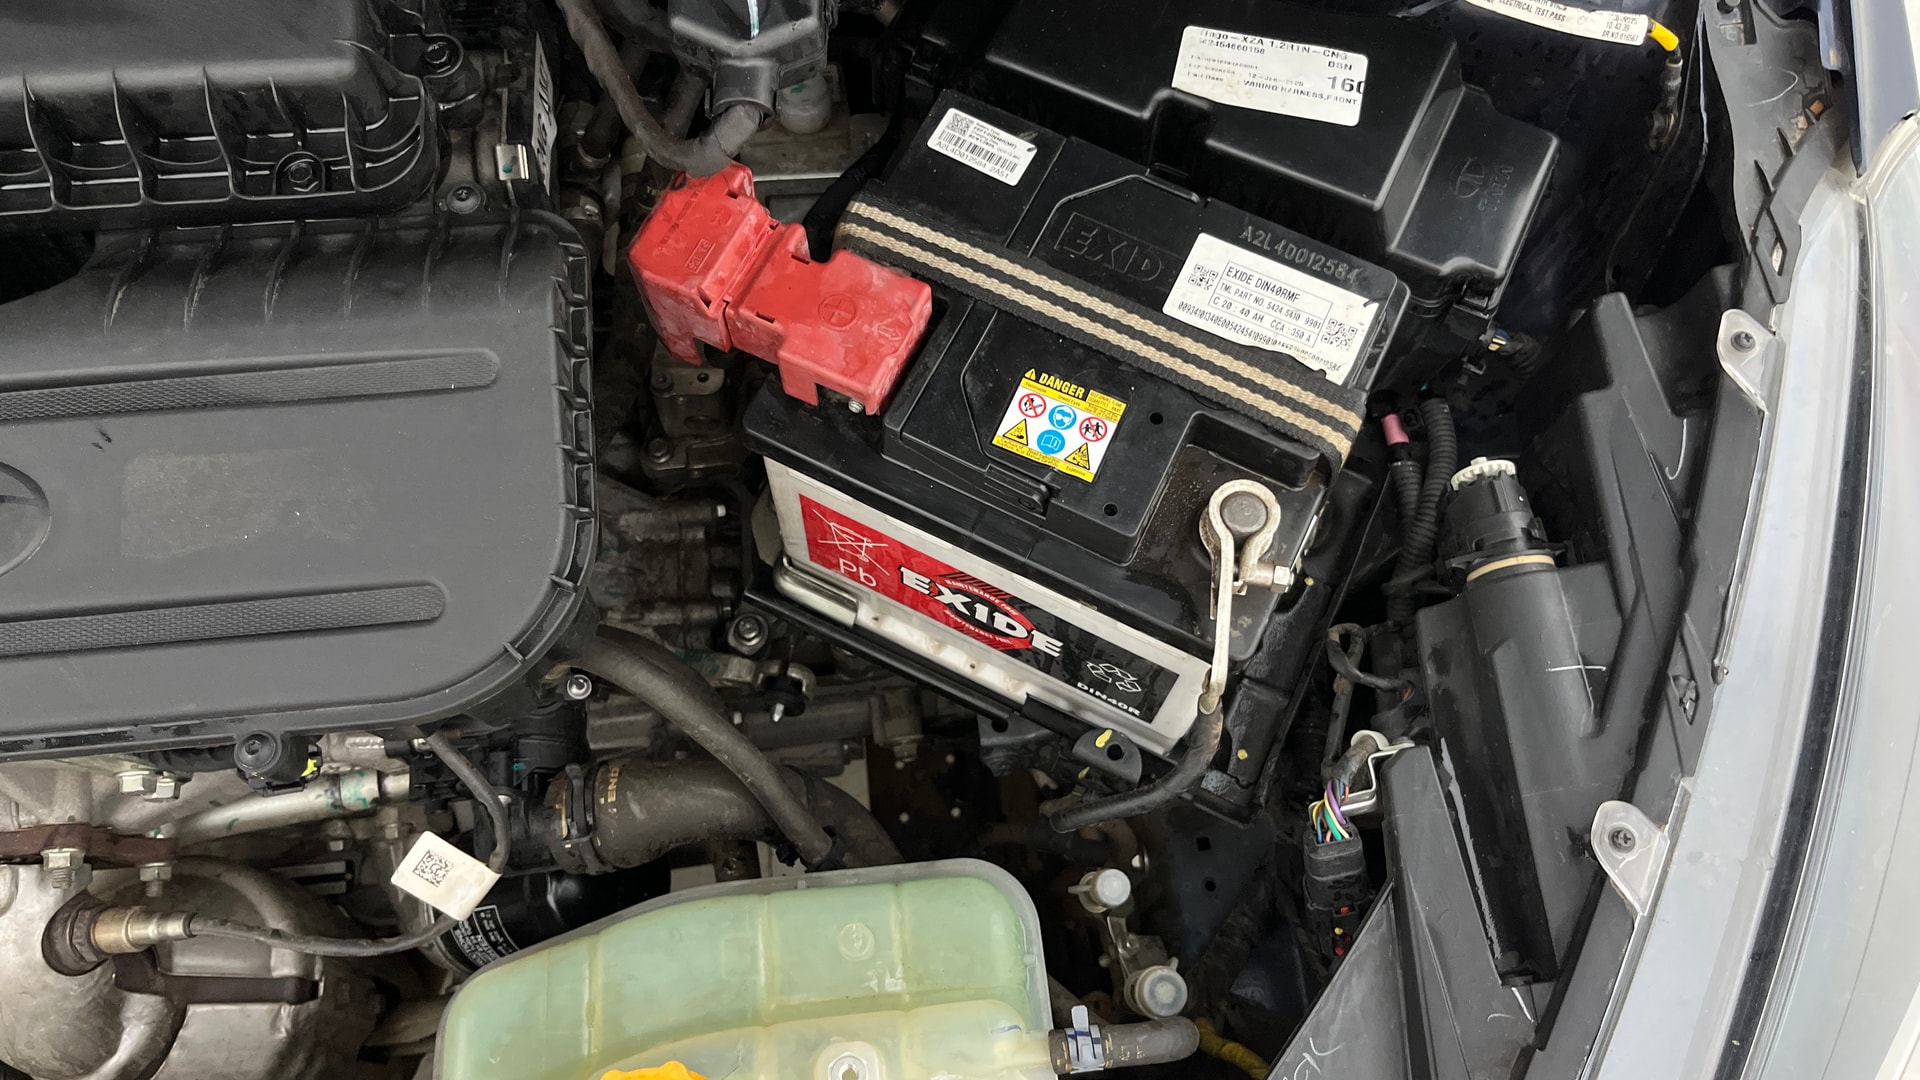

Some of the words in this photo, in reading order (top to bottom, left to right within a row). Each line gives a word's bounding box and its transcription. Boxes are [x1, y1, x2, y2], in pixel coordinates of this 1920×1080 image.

[1550, 10, 1566, 22] PASS
[1225, 266, 1254, 286] EXIDE
[1254, 277, 1301, 303] DIN40RMF
[1212, 296, 1220, 306] C
[1221, 299, 1233, 311] 20
[1240, 307, 1250, 318] 40
[1251, 312, 1264, 323] AH
[1270, 319, 1285, 333] CCA
[1290, 327, 1305, 339] 350
[1305, 333, 1312, 343] A
[1219, 282, 1233, 295] TML
[1233, 287, 1253, 303] PART
[1304, 316, 1322, 330] 9901
[1038, 372, 1085, 399] DANGER
[839, 558, 877, 587] Pb
[900, 566, 1064, 658] EXIDE
[1077, 681, 1141, 716] DIN40R
